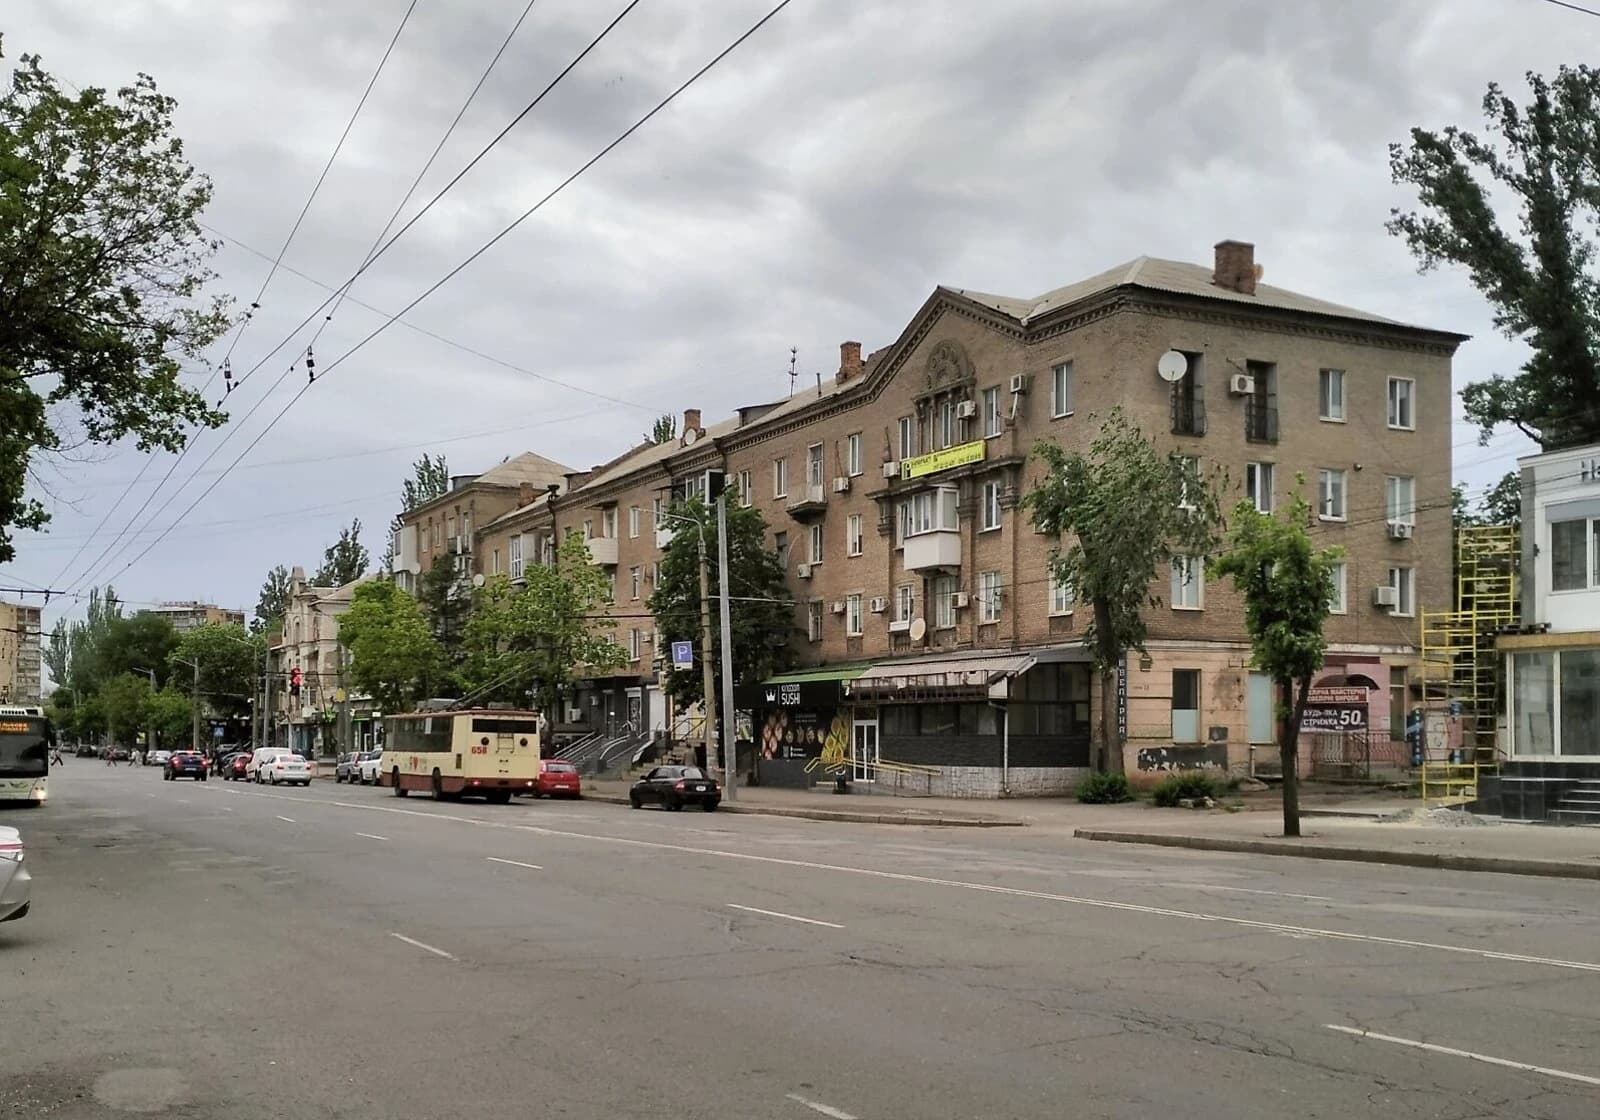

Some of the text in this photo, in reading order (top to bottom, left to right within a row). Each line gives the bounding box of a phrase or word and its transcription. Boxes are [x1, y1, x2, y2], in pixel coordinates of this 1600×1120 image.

[677, 645, 688, 660] P
[781, 693, 800, 704] SUSHI
[1339, 710, 1361, 725] 50
